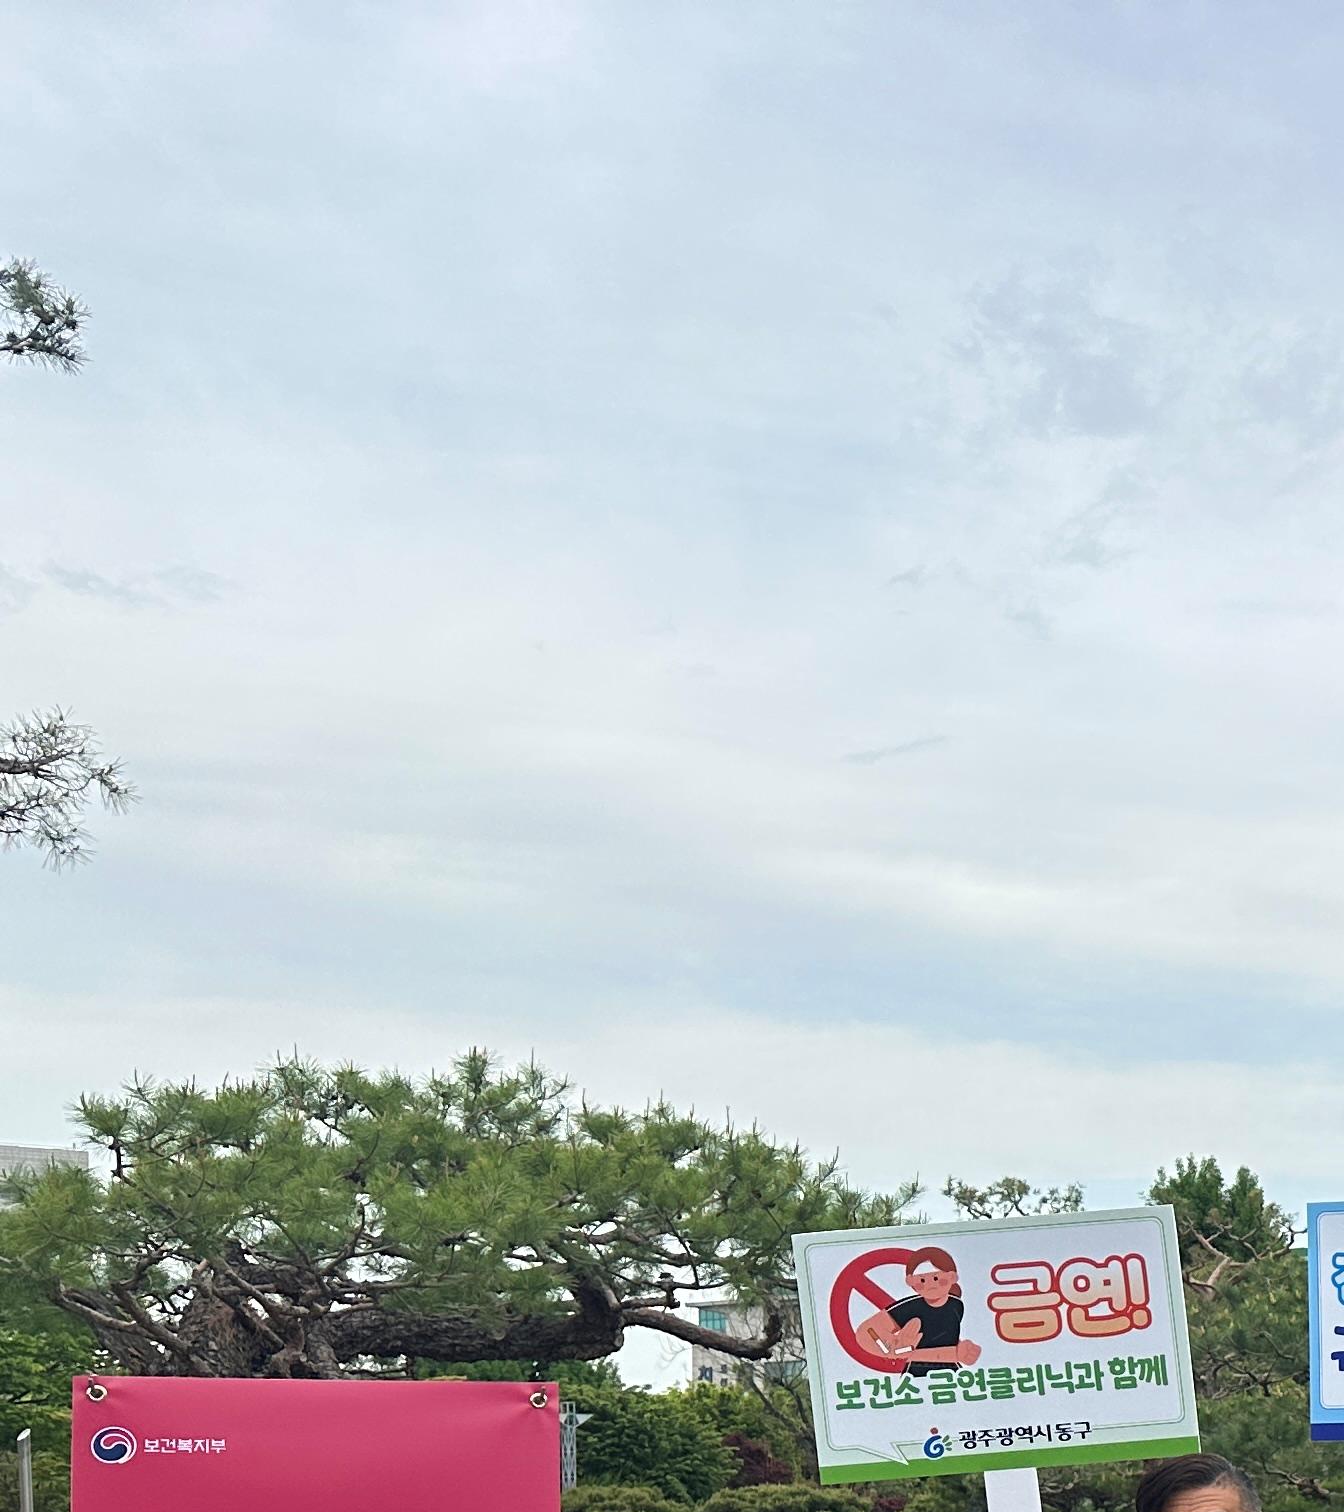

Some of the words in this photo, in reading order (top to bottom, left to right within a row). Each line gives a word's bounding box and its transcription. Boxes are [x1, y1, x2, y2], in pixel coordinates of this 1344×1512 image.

[986, 1252, 1152, 1344] 금연!
[835, 1377, 924, 1411] 보건소
[927, 1360, 1104, 1403] 금연클리닉과
[1108, 1354, 1169, 1390] 함께
[143, 1437, 227, 1455] 보건복지부
